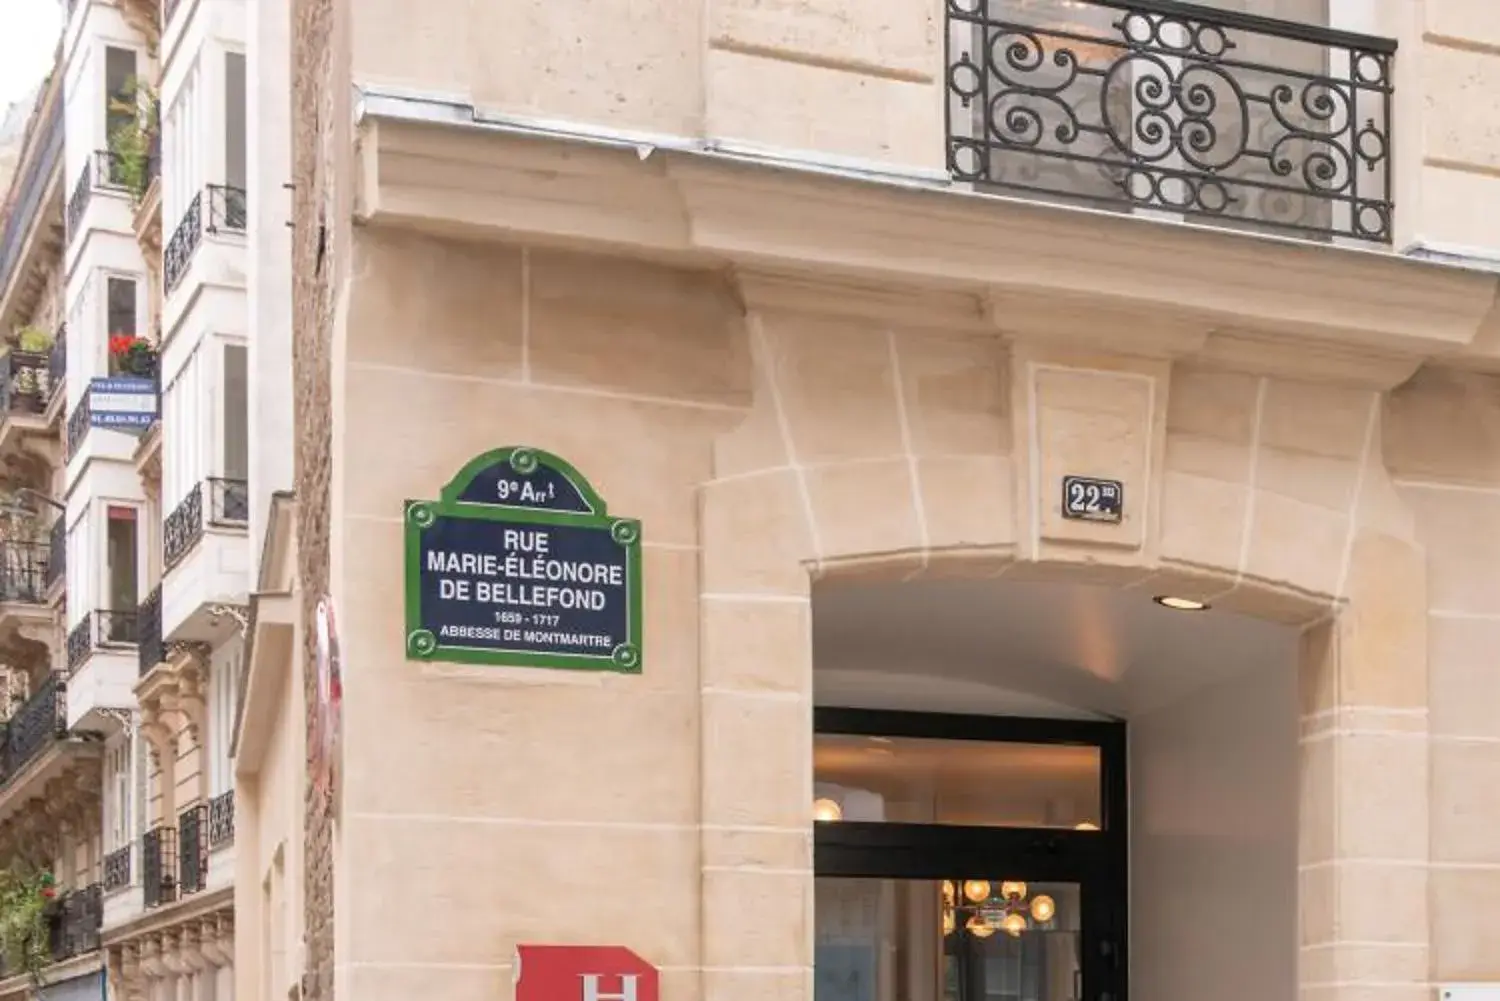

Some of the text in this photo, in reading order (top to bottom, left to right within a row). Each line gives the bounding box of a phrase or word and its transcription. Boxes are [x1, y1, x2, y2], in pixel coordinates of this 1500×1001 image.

[1070, 483, 1100, 511] 22
[503, 529, 549, 552] RUE
[427, 551, 623, 586] MARIE-ÉLÉONORE
[439, 579, 606, 611] DE BELLEFOND
[532, 614, 560, 627] 1717
[440, 624, 612, 647] ABBESSE DE MONTMARTRE
